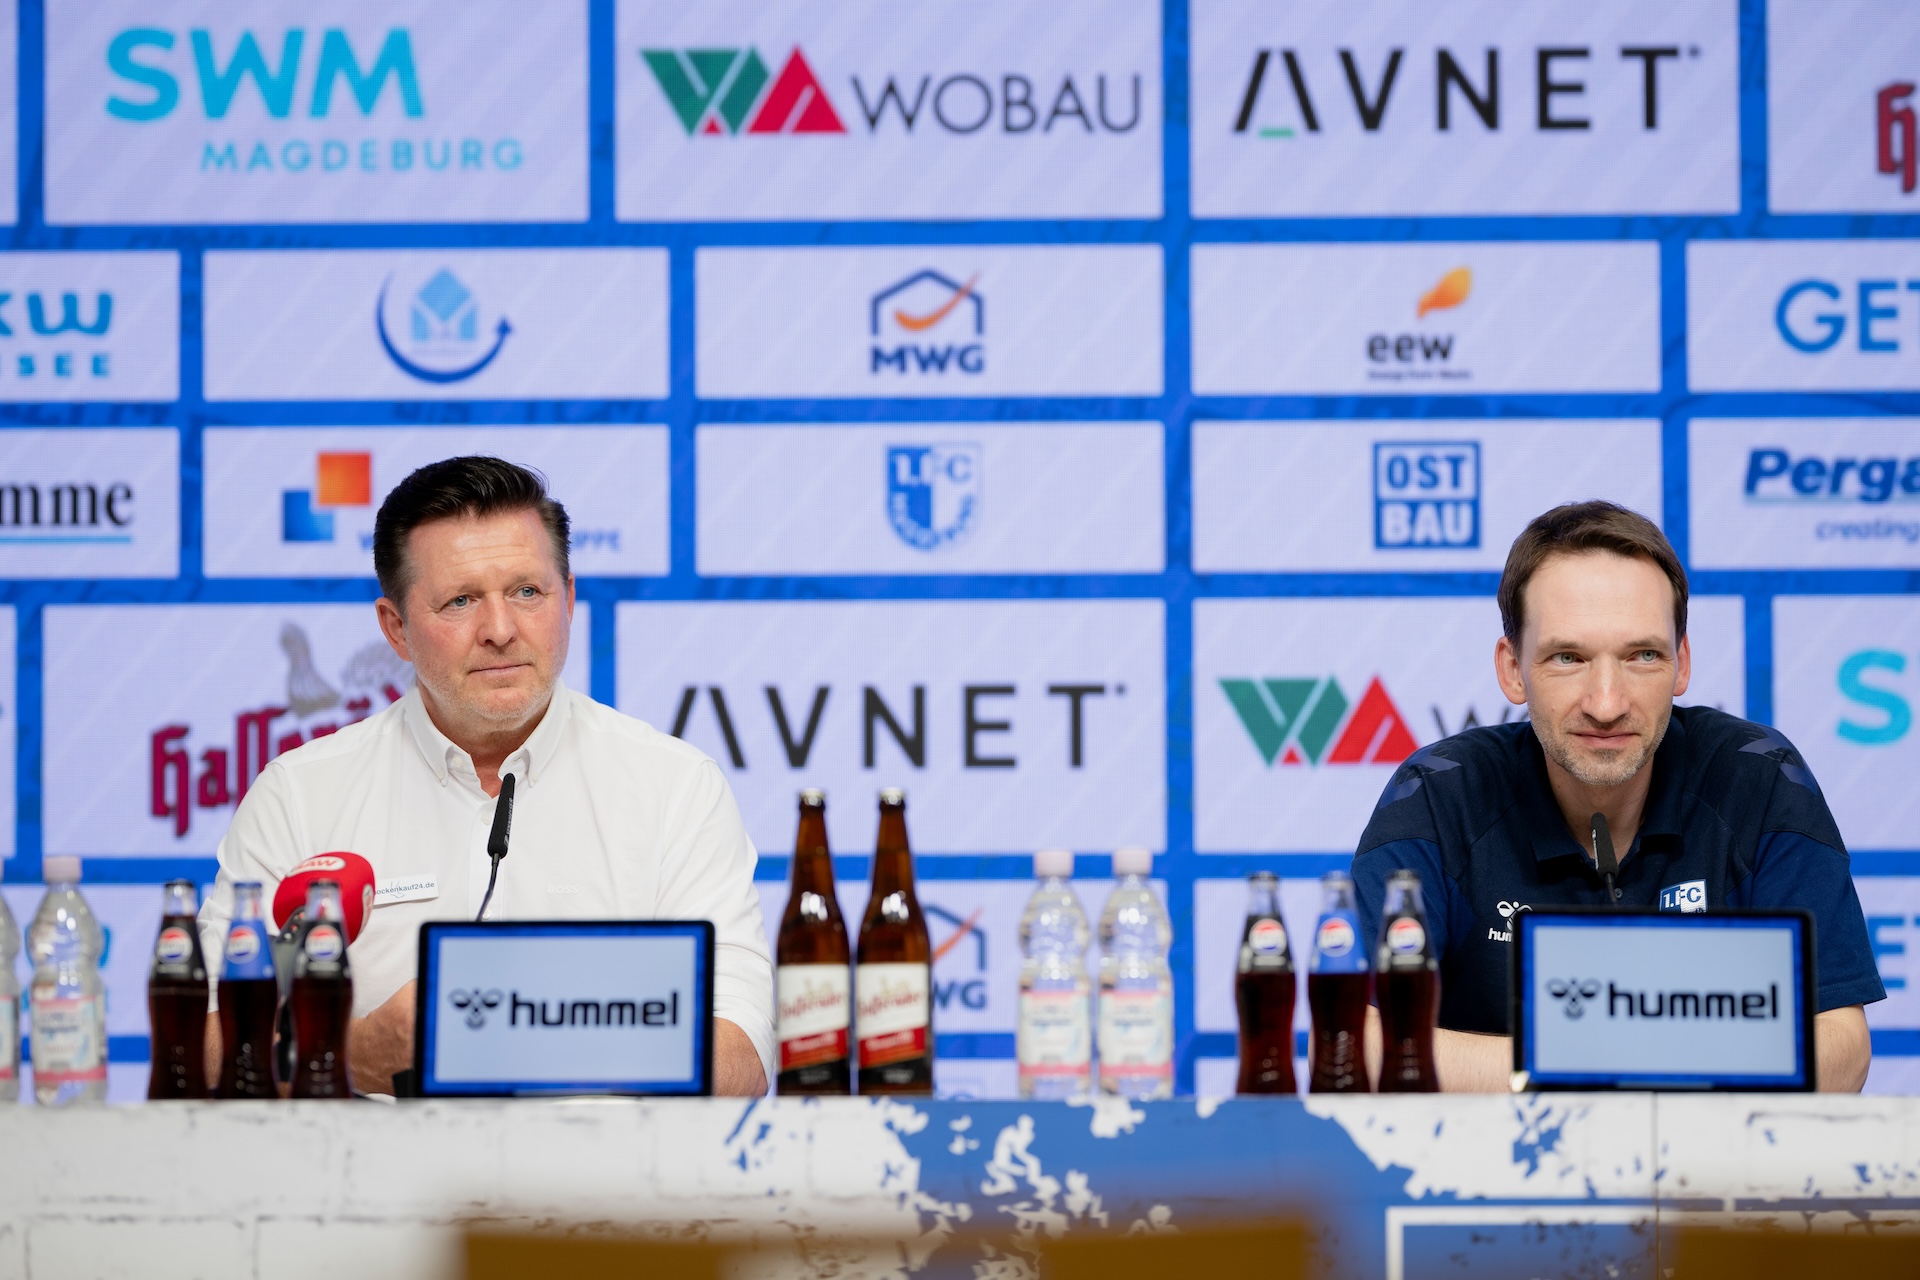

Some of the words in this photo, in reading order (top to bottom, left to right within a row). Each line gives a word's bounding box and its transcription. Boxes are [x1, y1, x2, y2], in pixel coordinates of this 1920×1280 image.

[105, 27, 426, 121] SWM
[1232, 46, 1680, 137] AVNET
[850, 73, 1143, 135] WOBAU
[200, 138, 525, 173] MAGDEBURG
[0, 353, 110, 378] SEE
[871, 343, 985, 374] MWG
[1366, 334, 1454, 363] eew
[1387, 455, 1467, 489] OST
[1382, 503, 1472, 544] BAU
[670, 684, 1107, 770] AVNET
[547, 885, 578, 894] BOSS
[1663, 887, 1702, 909] 1.FC
[510, 992, 679, 1029] hummel
[1608, 981, 1778, 1020] hummel
